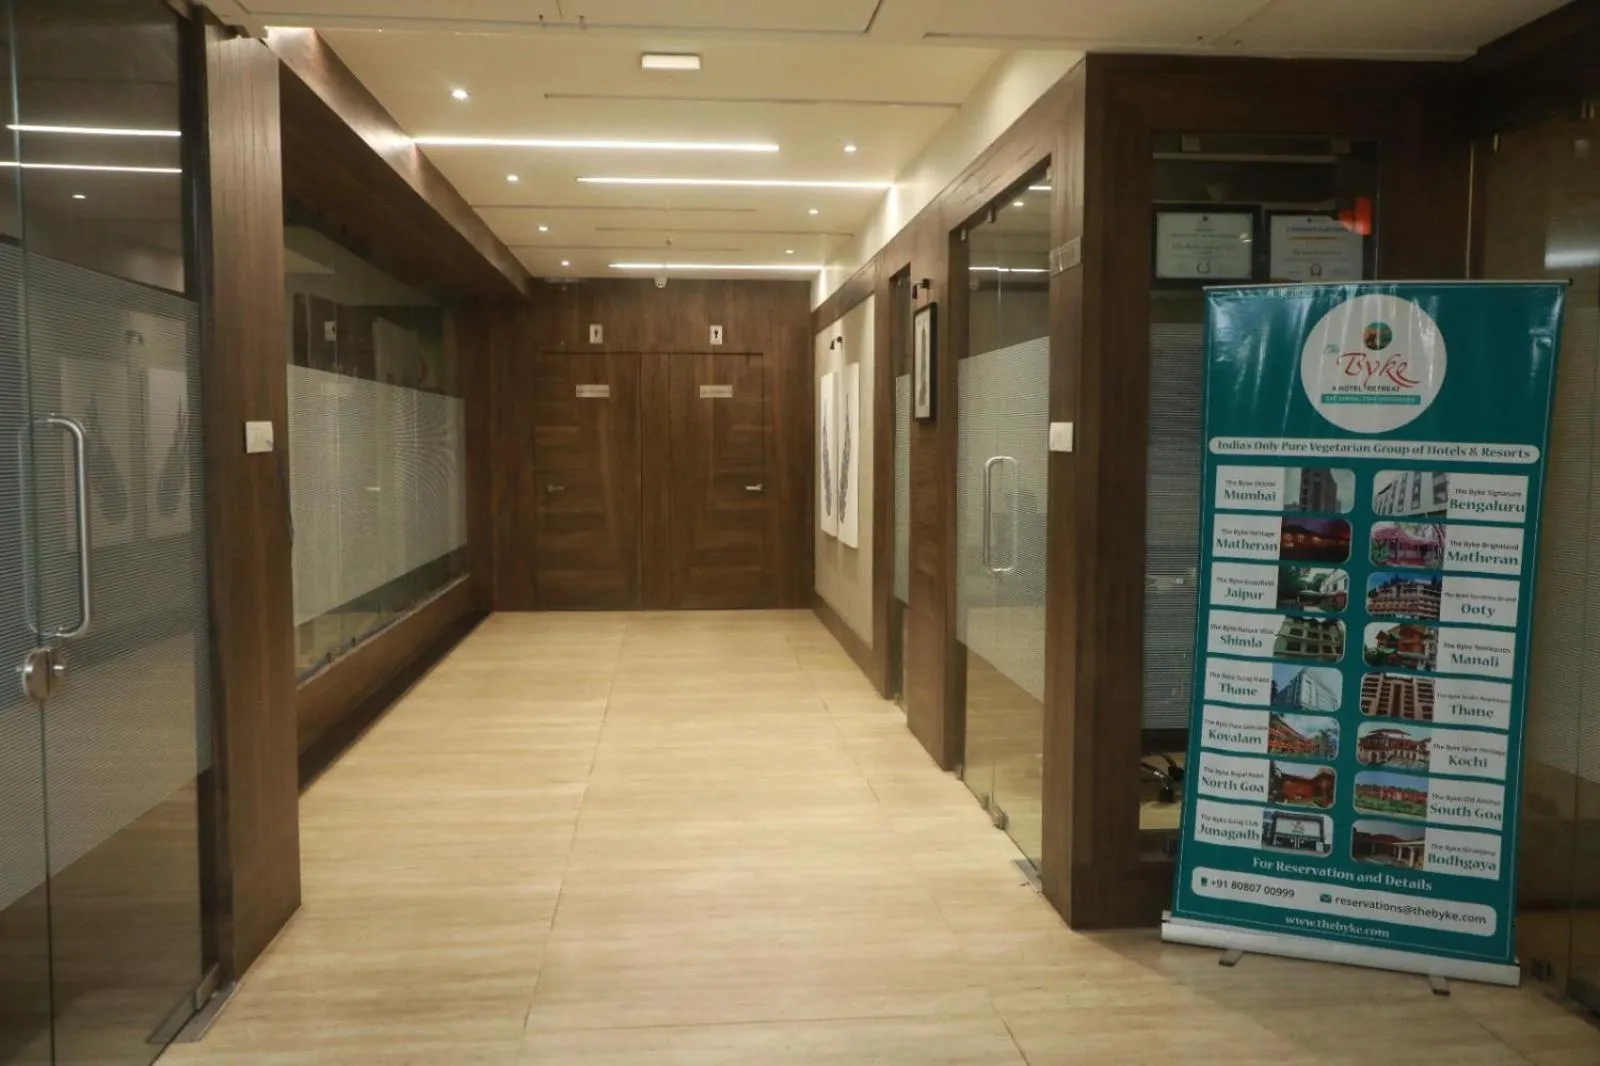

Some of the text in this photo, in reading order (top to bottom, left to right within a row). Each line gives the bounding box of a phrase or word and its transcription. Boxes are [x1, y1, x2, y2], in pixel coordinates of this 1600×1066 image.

[1337, 353, 1422, 388] Byke
[1366, 385, 1400, 393] RETREAT
[1254, 440, 1278, 452] Only
[1281, 441, 1307, 451] Pure
[1309, 442, 1370, 454] Vegetarian
[1373, 444, 1410, 456] Group
[1412, 445, 1424, 454] of
[1427, 446, 1466, 456] Hotels
[1468, 447, 1478, 457] &
[1481, 447, 1531, 459] Resorts
[1224, 489, 1277, 502] Mumbai
[1488, 489, 1522, 498] Signature
[1450, 498, 1525, 513] Bengaluru
[1216, 538, 1278, 552] Matheran
[1463, 541, 1480, 549] Byke
[1448, 550, 1519, 565] Matheran
[1224, 587, 1264, 602] Jaipur
[1461, 603, 1496, 618] Ooty
[1220, 634, 1262, 649] Shimla
[1451, 653, 1499, 668] Manali
[1218, 681, 1258, 697] Thane
[1450, 703, 1493, 717] Thane
[1208, 729, 1262, 745] Kovalam
[1448, 754, 1487, 768] Kochi
[1201, 776, 1265, 793] North Goa
[1430, 804, 1502, 821] South Goa
[1199, 824, 1260, 841] Junagadh
[1427, 853, 1496, 872] Bodhgaya
[1253, 857, 1432, 891] For Reservation and Details
[1211, 879, 1295, 898] +91 80807 00999
[1334, 896, 1487, 925] reservations@thebyke.com
[1285, 915, 1390, 938] www.thebyke.com
